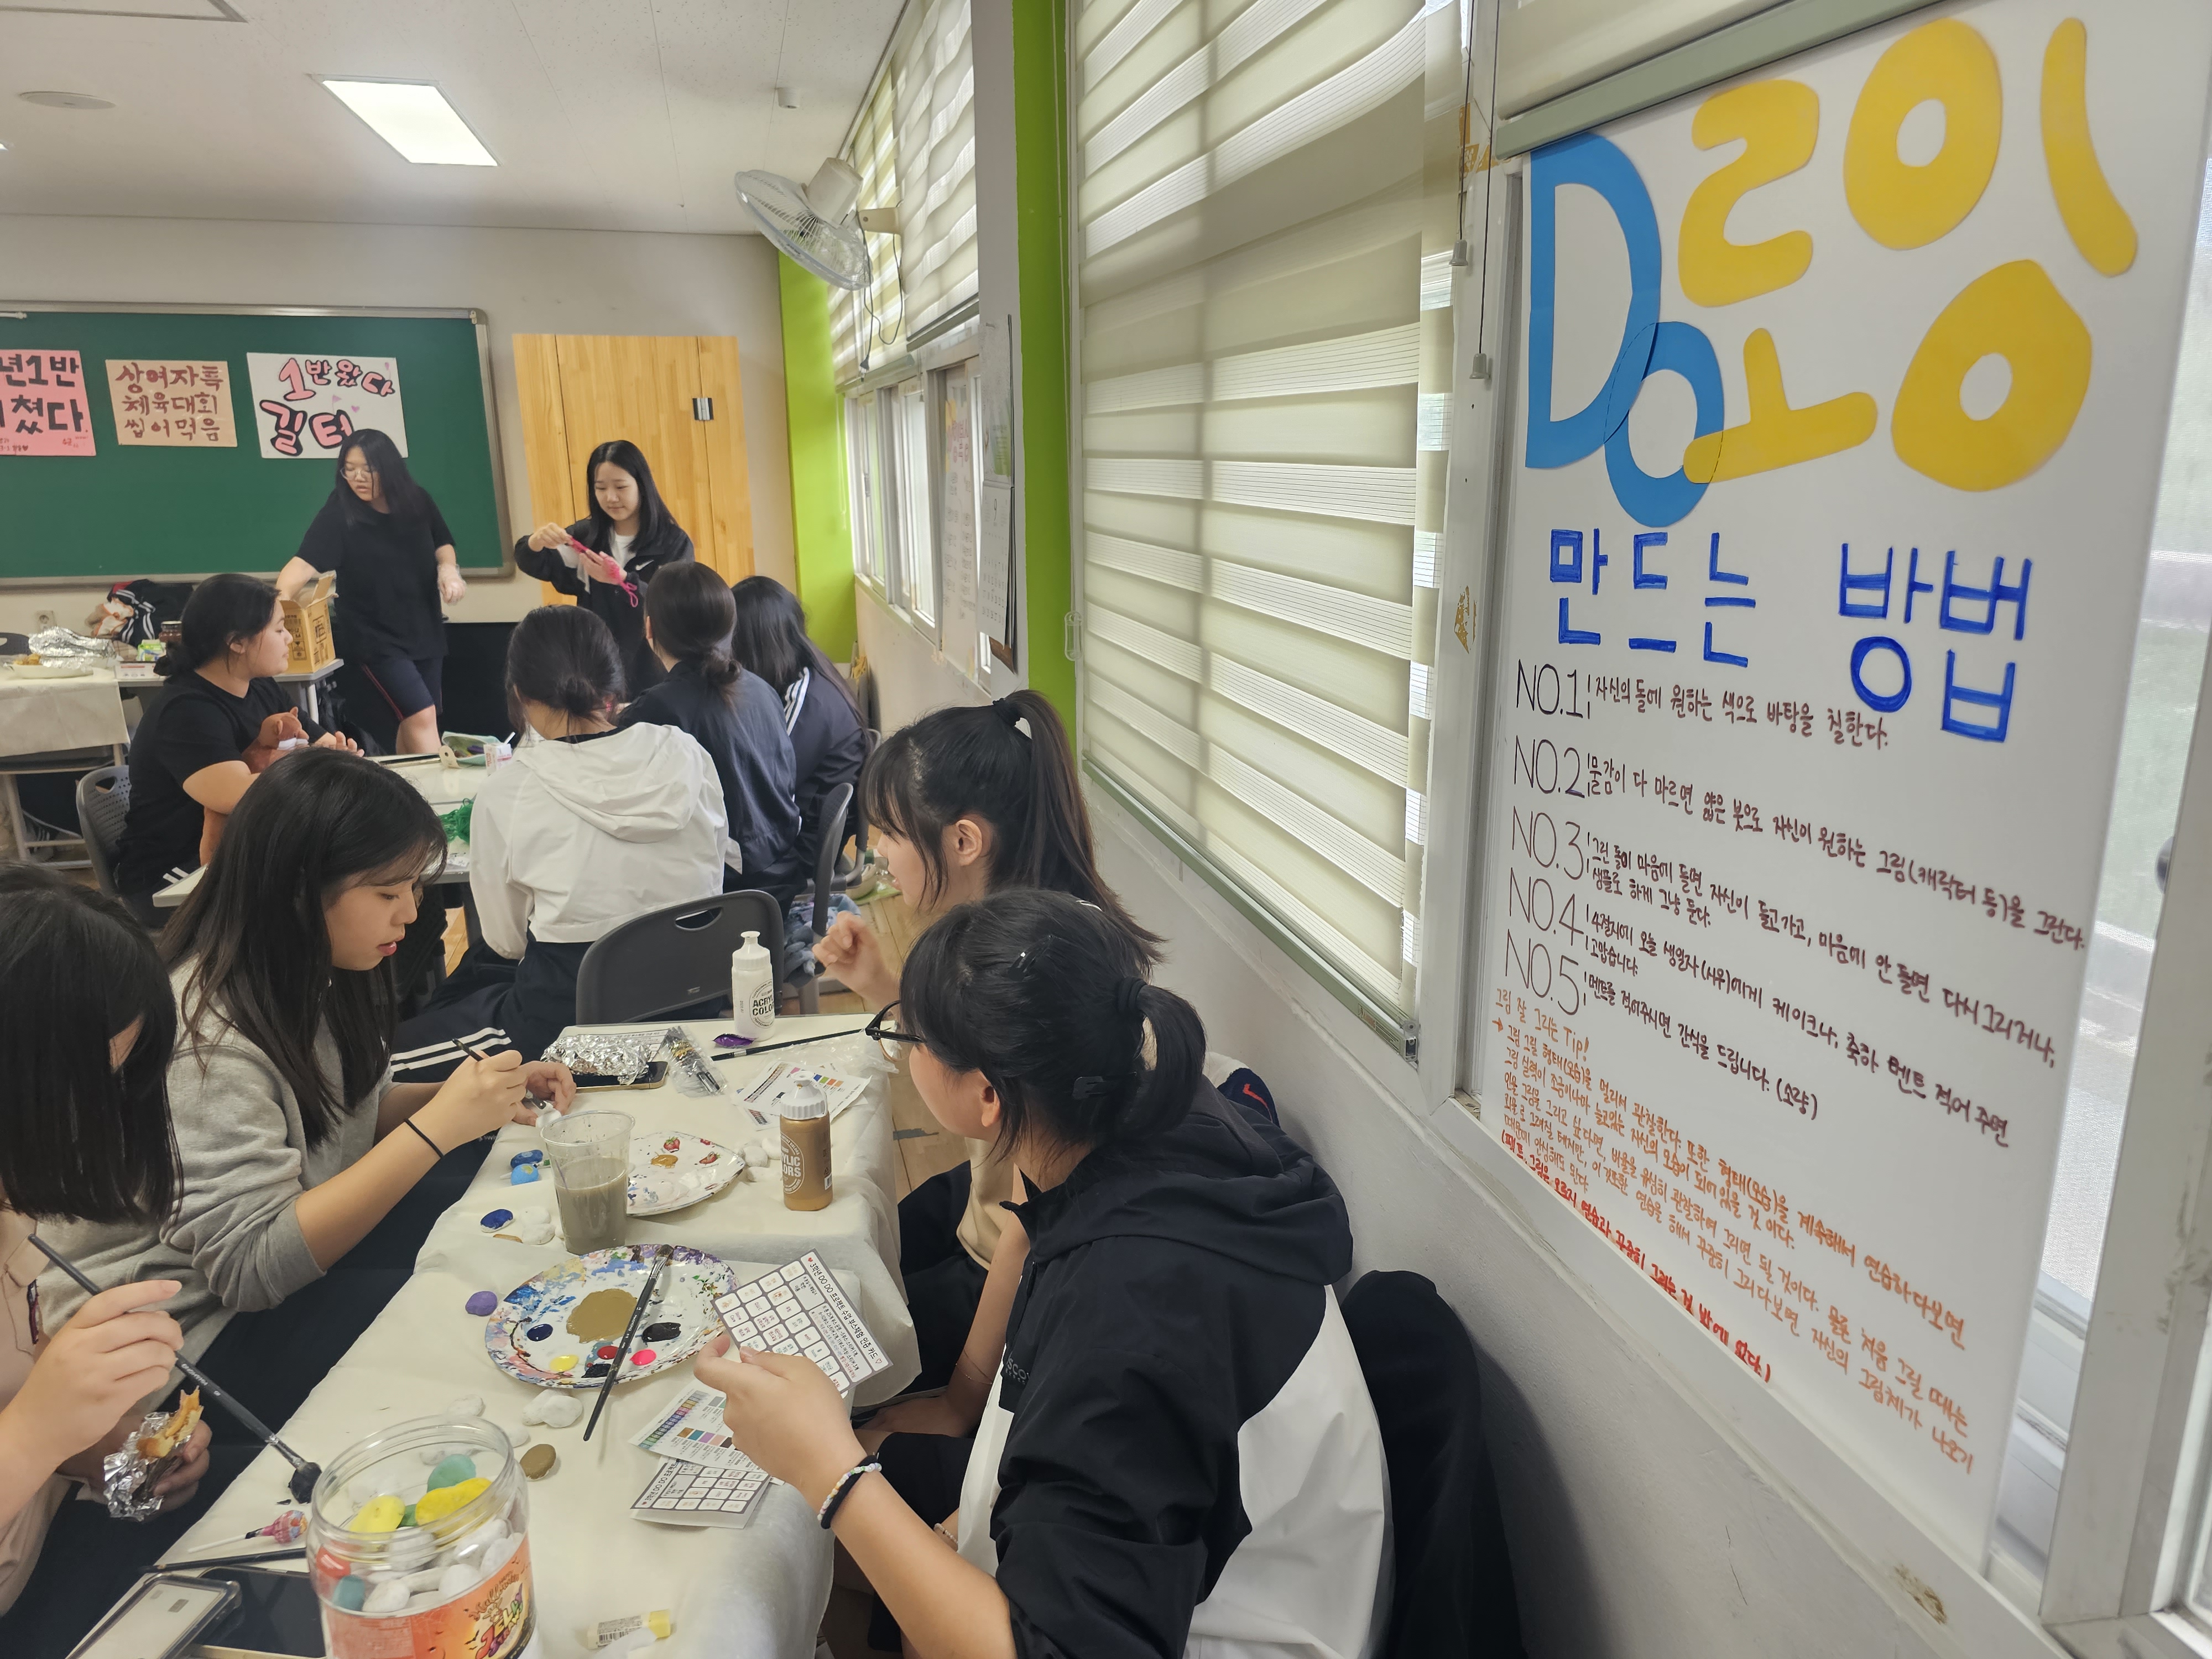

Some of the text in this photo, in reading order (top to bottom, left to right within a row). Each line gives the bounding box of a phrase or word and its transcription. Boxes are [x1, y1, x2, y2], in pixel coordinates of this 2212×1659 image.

[121, 391, 218, 416] 체육대회
[1550, 527, 2032, 743] 만드는 방법
[1595, 676, 1888, 750] 자신의 돌에 원하는 색으로 바탕을 칠한다.
[1589, 755, 1626, 795] 물감이
[1633, 769, 1648, 797] 다
[1654, 774, 1693, 816] 마르면
[1733, 798, 1764, 832] 붓으로
[1772, 815, 1812, 844] 자신이
[1817, 827, 1866, 868] 원하는
[1592, 837, 1610, 864] 그린
[1637, 853, 1673, 883] 마음에
[1710, 884, 1749, 920] 자신이
[1818, 932, 1866, 969] 마음에
[1875, 954, 1892, 984] 안
[1629, 878, 1653, 905] 하게
[1658, 888, 1681, 916] 그냥
[1495, 988, 1589, 1062] 그림 잘 그리는 Tip!
[1588, 974, 1616, 1006] 멘트를
[1677, 1023, 1709, 1060] 간식을
[1717, 1044, 1770, 1092] 드립니다.
[1639, 931, 1658, 957] 오늘
[1846, 1031, 1880, 1073] 축하
[1504, 1046, 1519, 1070] 그림
[1522, 1055, 1546, 1088] 실력이
[1551, 1073, 1591, 1116] 조금이나마
[1630, 1128, 1658, 1164] 자신의
[1747, 1204, 1762, 1231] 것
[1507, 1024, 1520, 1048] 그림
[1599, 1078, 1627, 1113] 멀리서
[1631, 1102, 1682, 1153] 관찰한다.
[1687, 1139, 1710, 1173] 또한
[1797, 1211, 1856, 1267] 계속해서
[1545, 1099, 1568, 1126] 그리고
[1640, 1167, 1667, 1203] 유심히
[1670, 1187, 1718, 1238] 관찰하여
[1723, 1228, 1751, 1266] 그리면
[1759, 1253, 1774, 1285] 될
[1861, 1327, 1888, 1373] 처음
[1928, 1386, 1968, 1439] 때는
[1635, 1190, 1662, 1224] 연습을
[1668, 1214, 1691, 1246] 해서
[1696, 1234, 1729, 1280] 꾸준히
[1811, 1327, 1849, 1375] 자신의
[1858, 1367, 1923, 1430] 그림체가
[1931, 1425, 1974, 1475] 나오기
